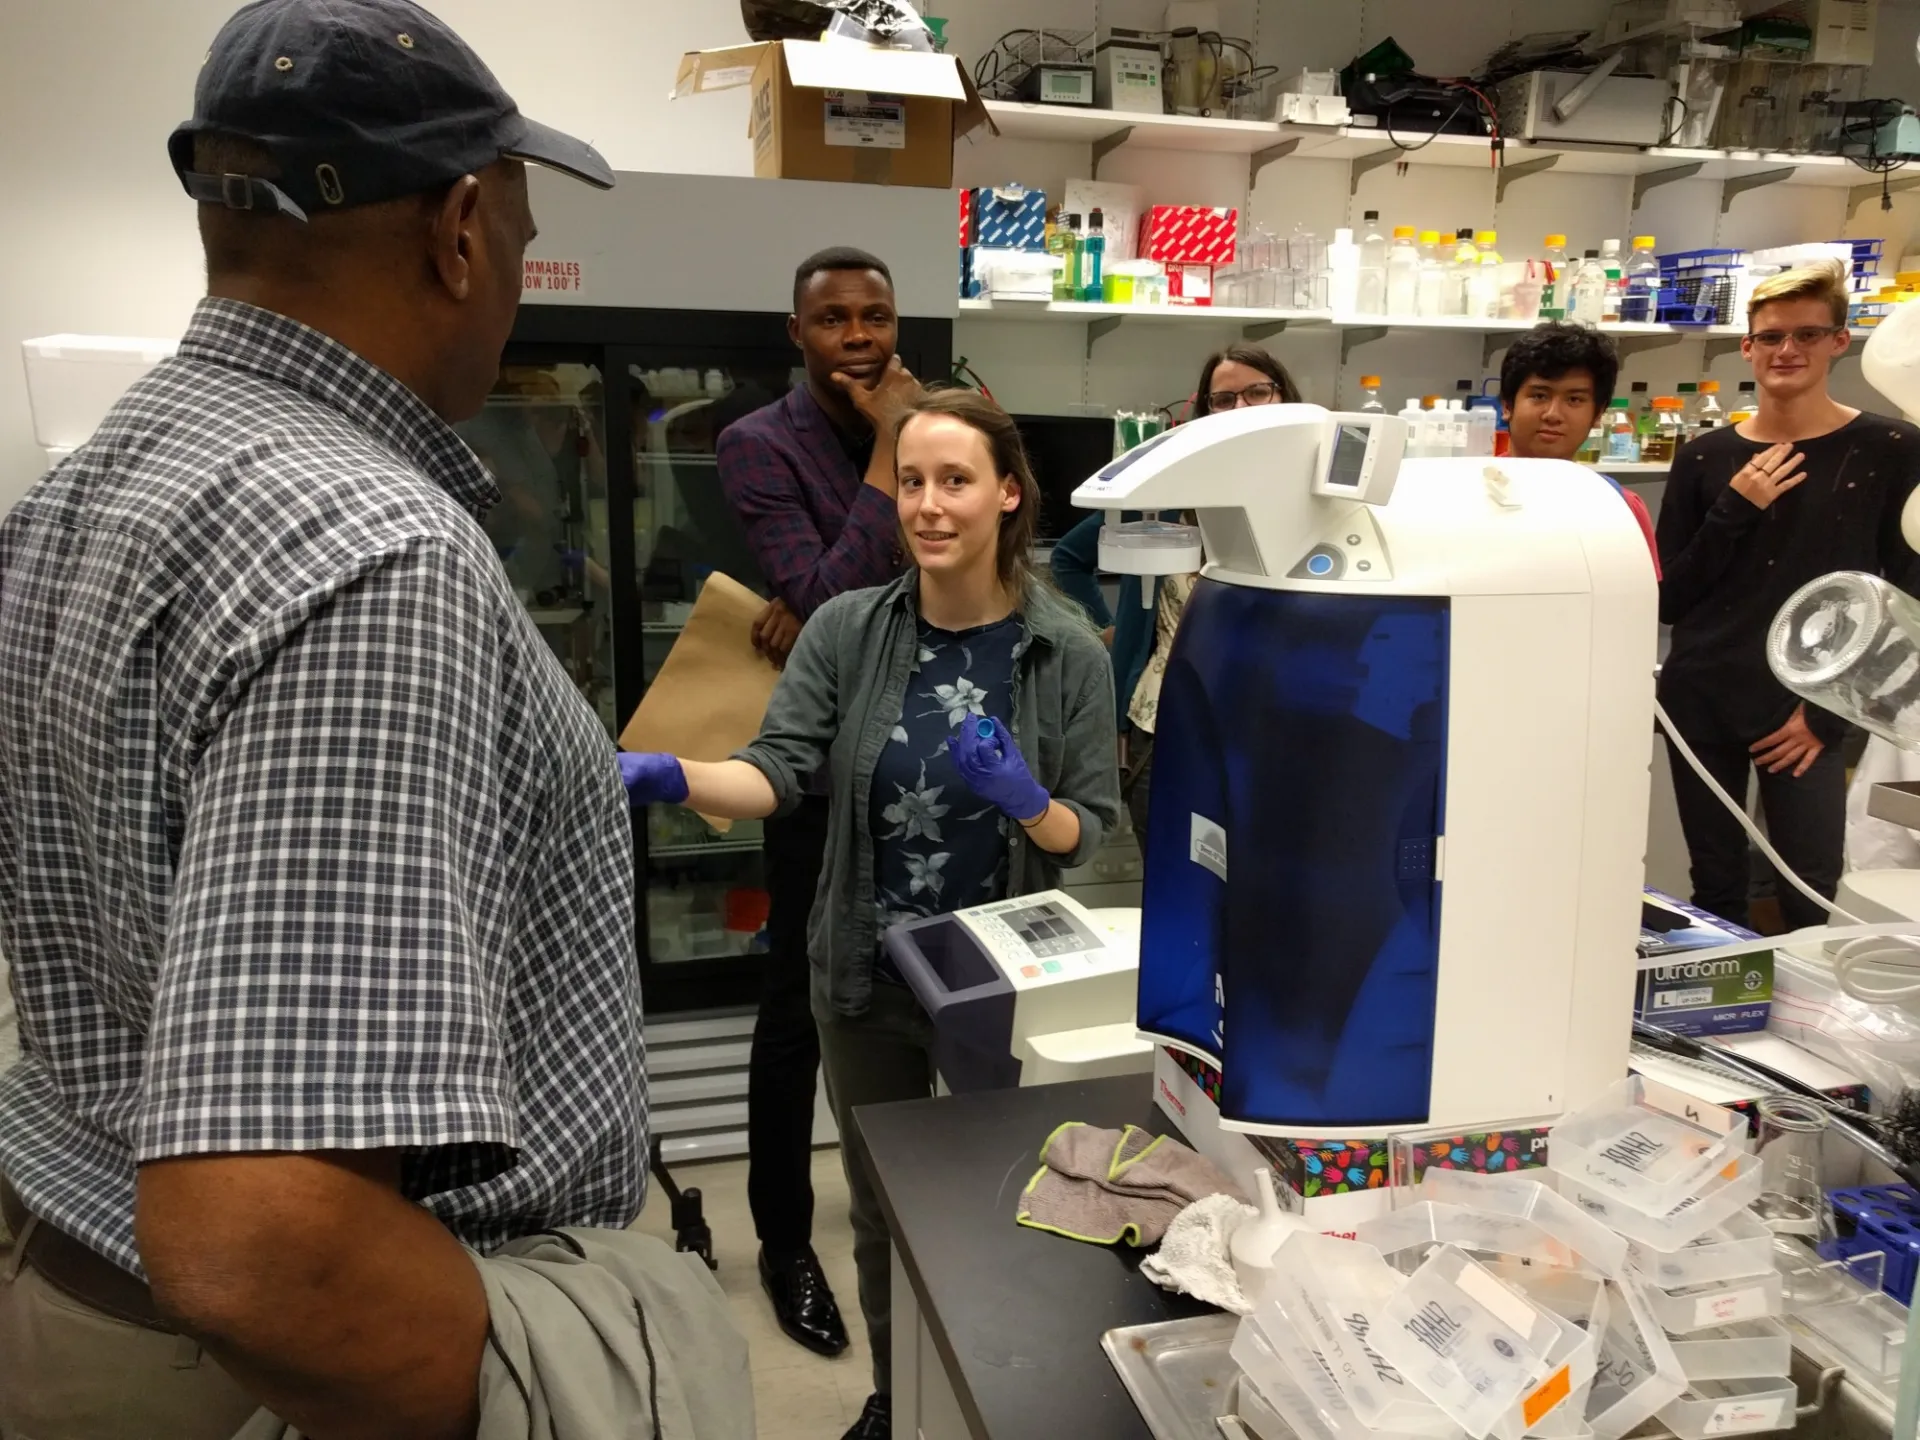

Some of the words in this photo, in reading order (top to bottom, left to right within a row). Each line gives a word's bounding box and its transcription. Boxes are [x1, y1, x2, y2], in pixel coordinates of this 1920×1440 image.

[523, 261, 580, 276] MMABLES
[523, 276, 542, 289] OW
[574, 278, 581, 291] F
[1661, 994, 1669, 1006] L
